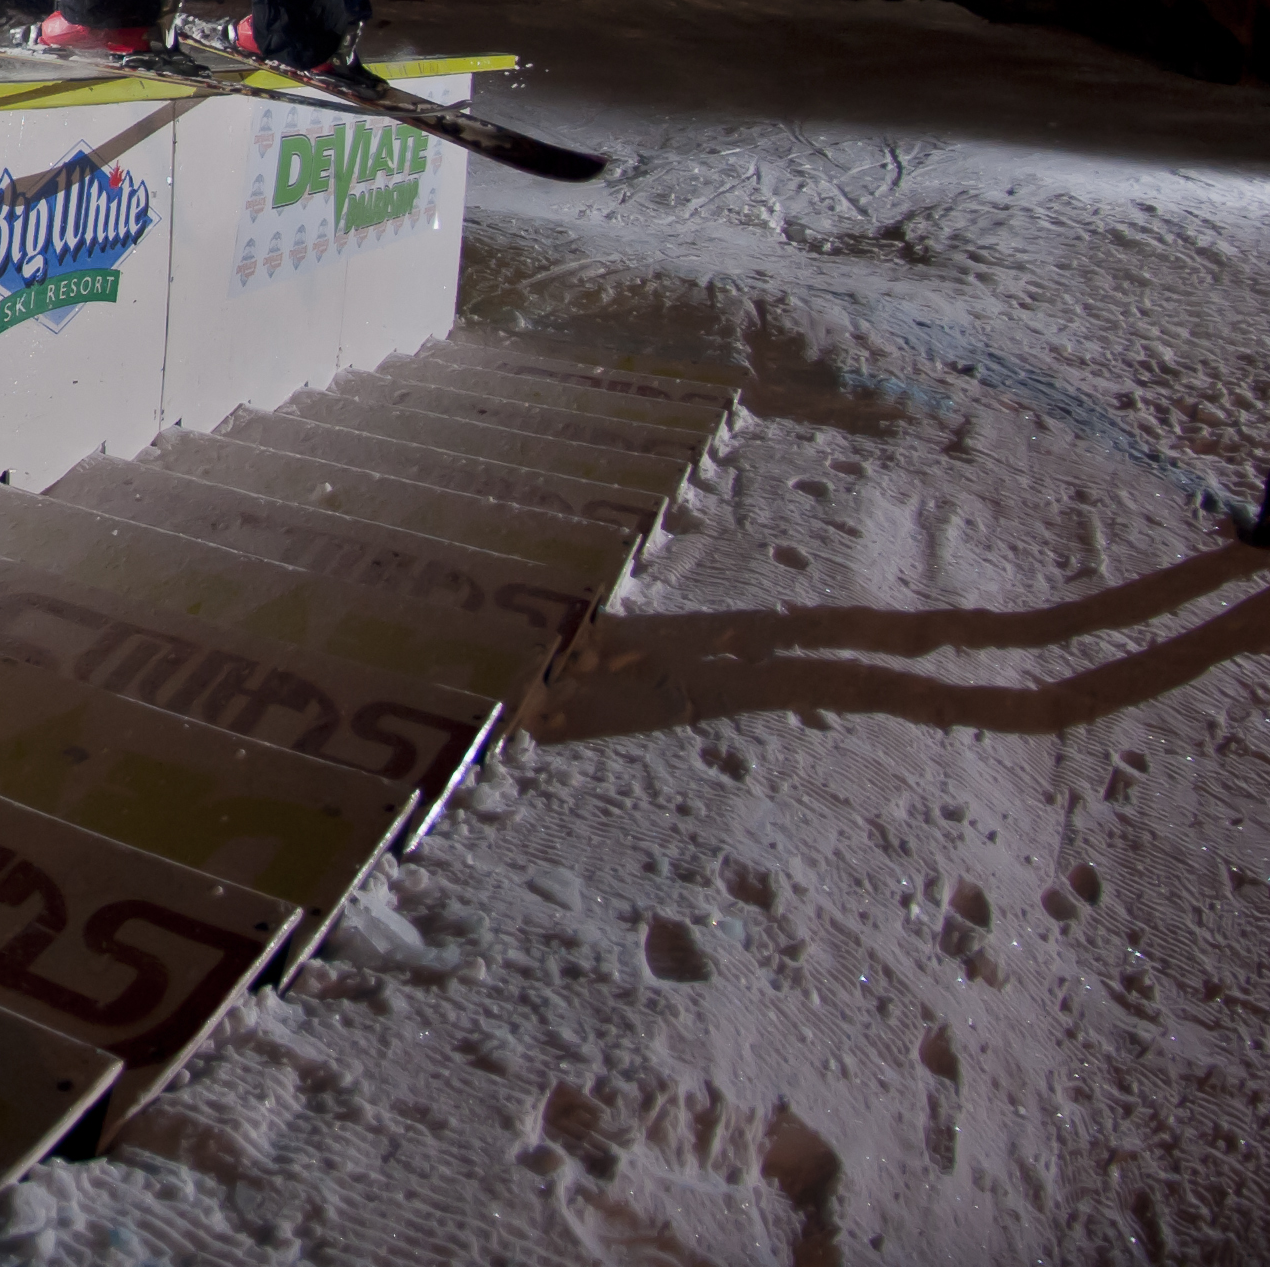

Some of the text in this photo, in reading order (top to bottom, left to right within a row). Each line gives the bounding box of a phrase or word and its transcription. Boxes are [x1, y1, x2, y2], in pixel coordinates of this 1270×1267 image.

[271, 120, 429, 235] DEVIATE
[3, 276, 115, 322] SKI RESORT
